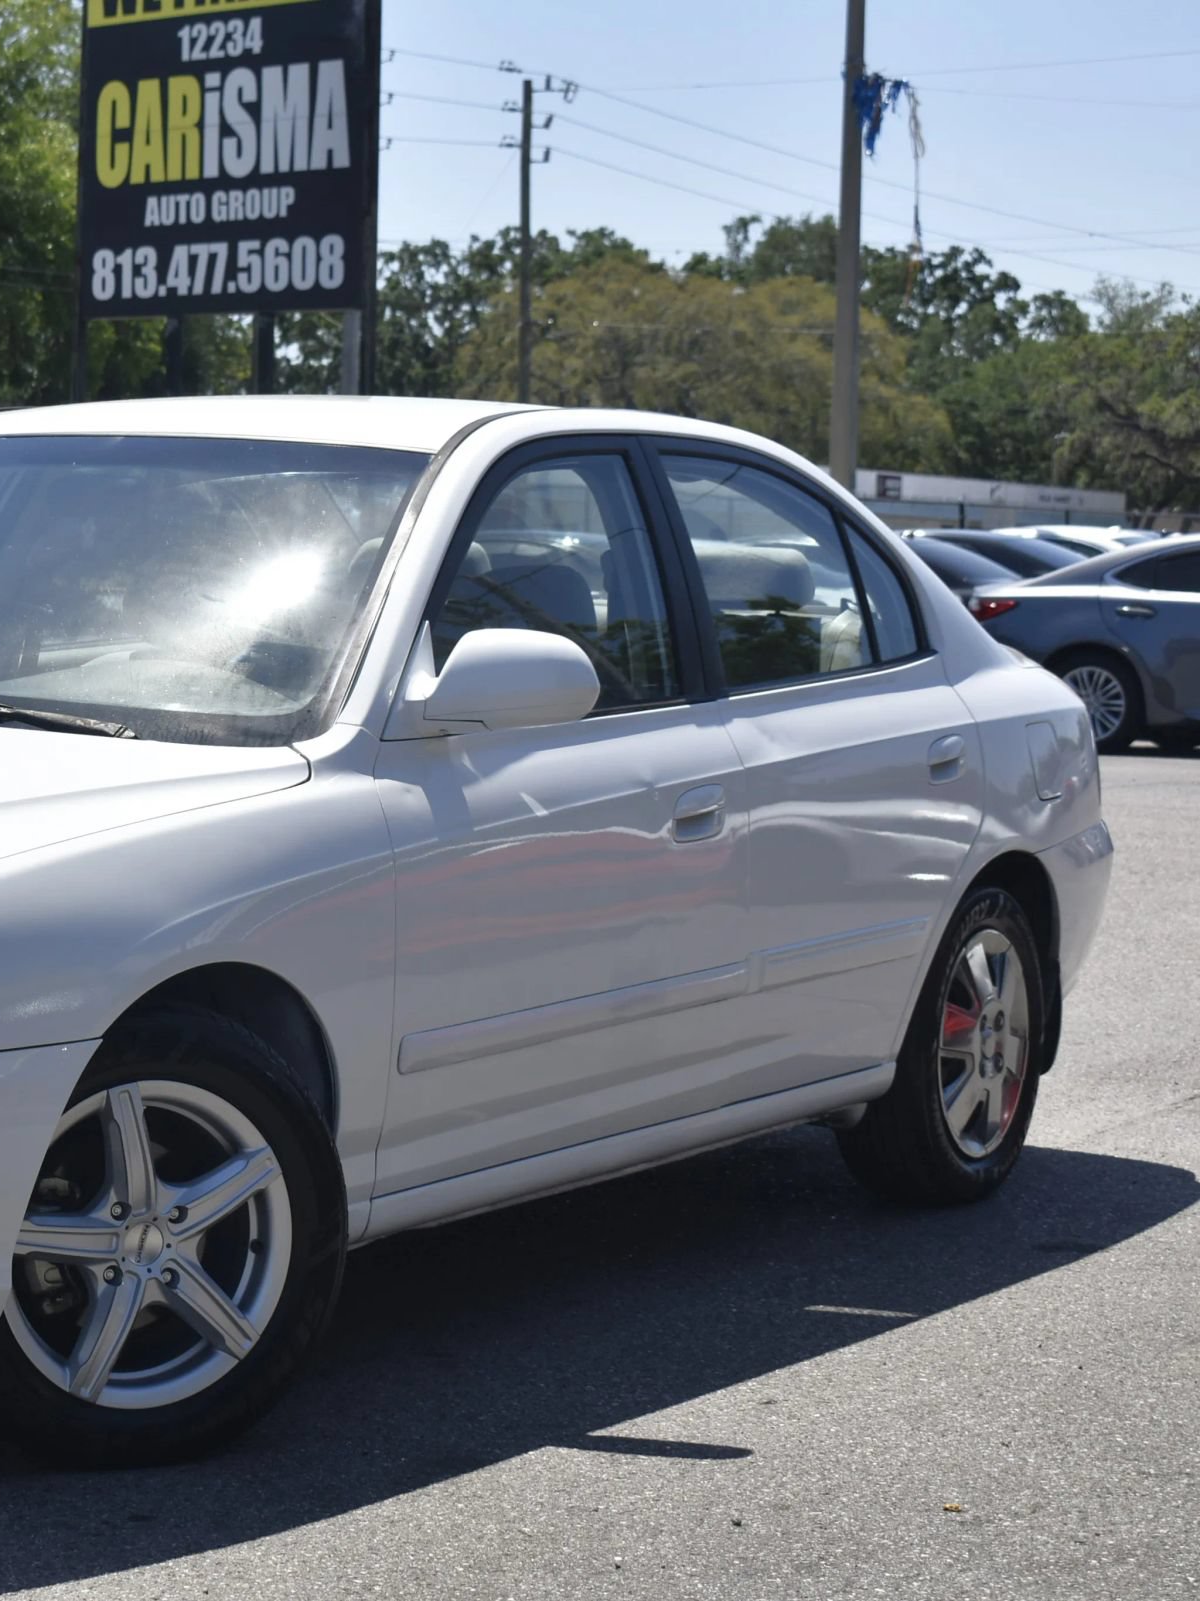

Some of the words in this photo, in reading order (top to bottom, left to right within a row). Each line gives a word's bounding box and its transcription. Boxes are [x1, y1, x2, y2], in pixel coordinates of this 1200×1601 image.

[177, 17, 263, 62] 12234
[144, 192, 206, 227] AUTO
[212, 186, 295, 223] GROUP
[92, 234, 345, 301] 813.477.5608
